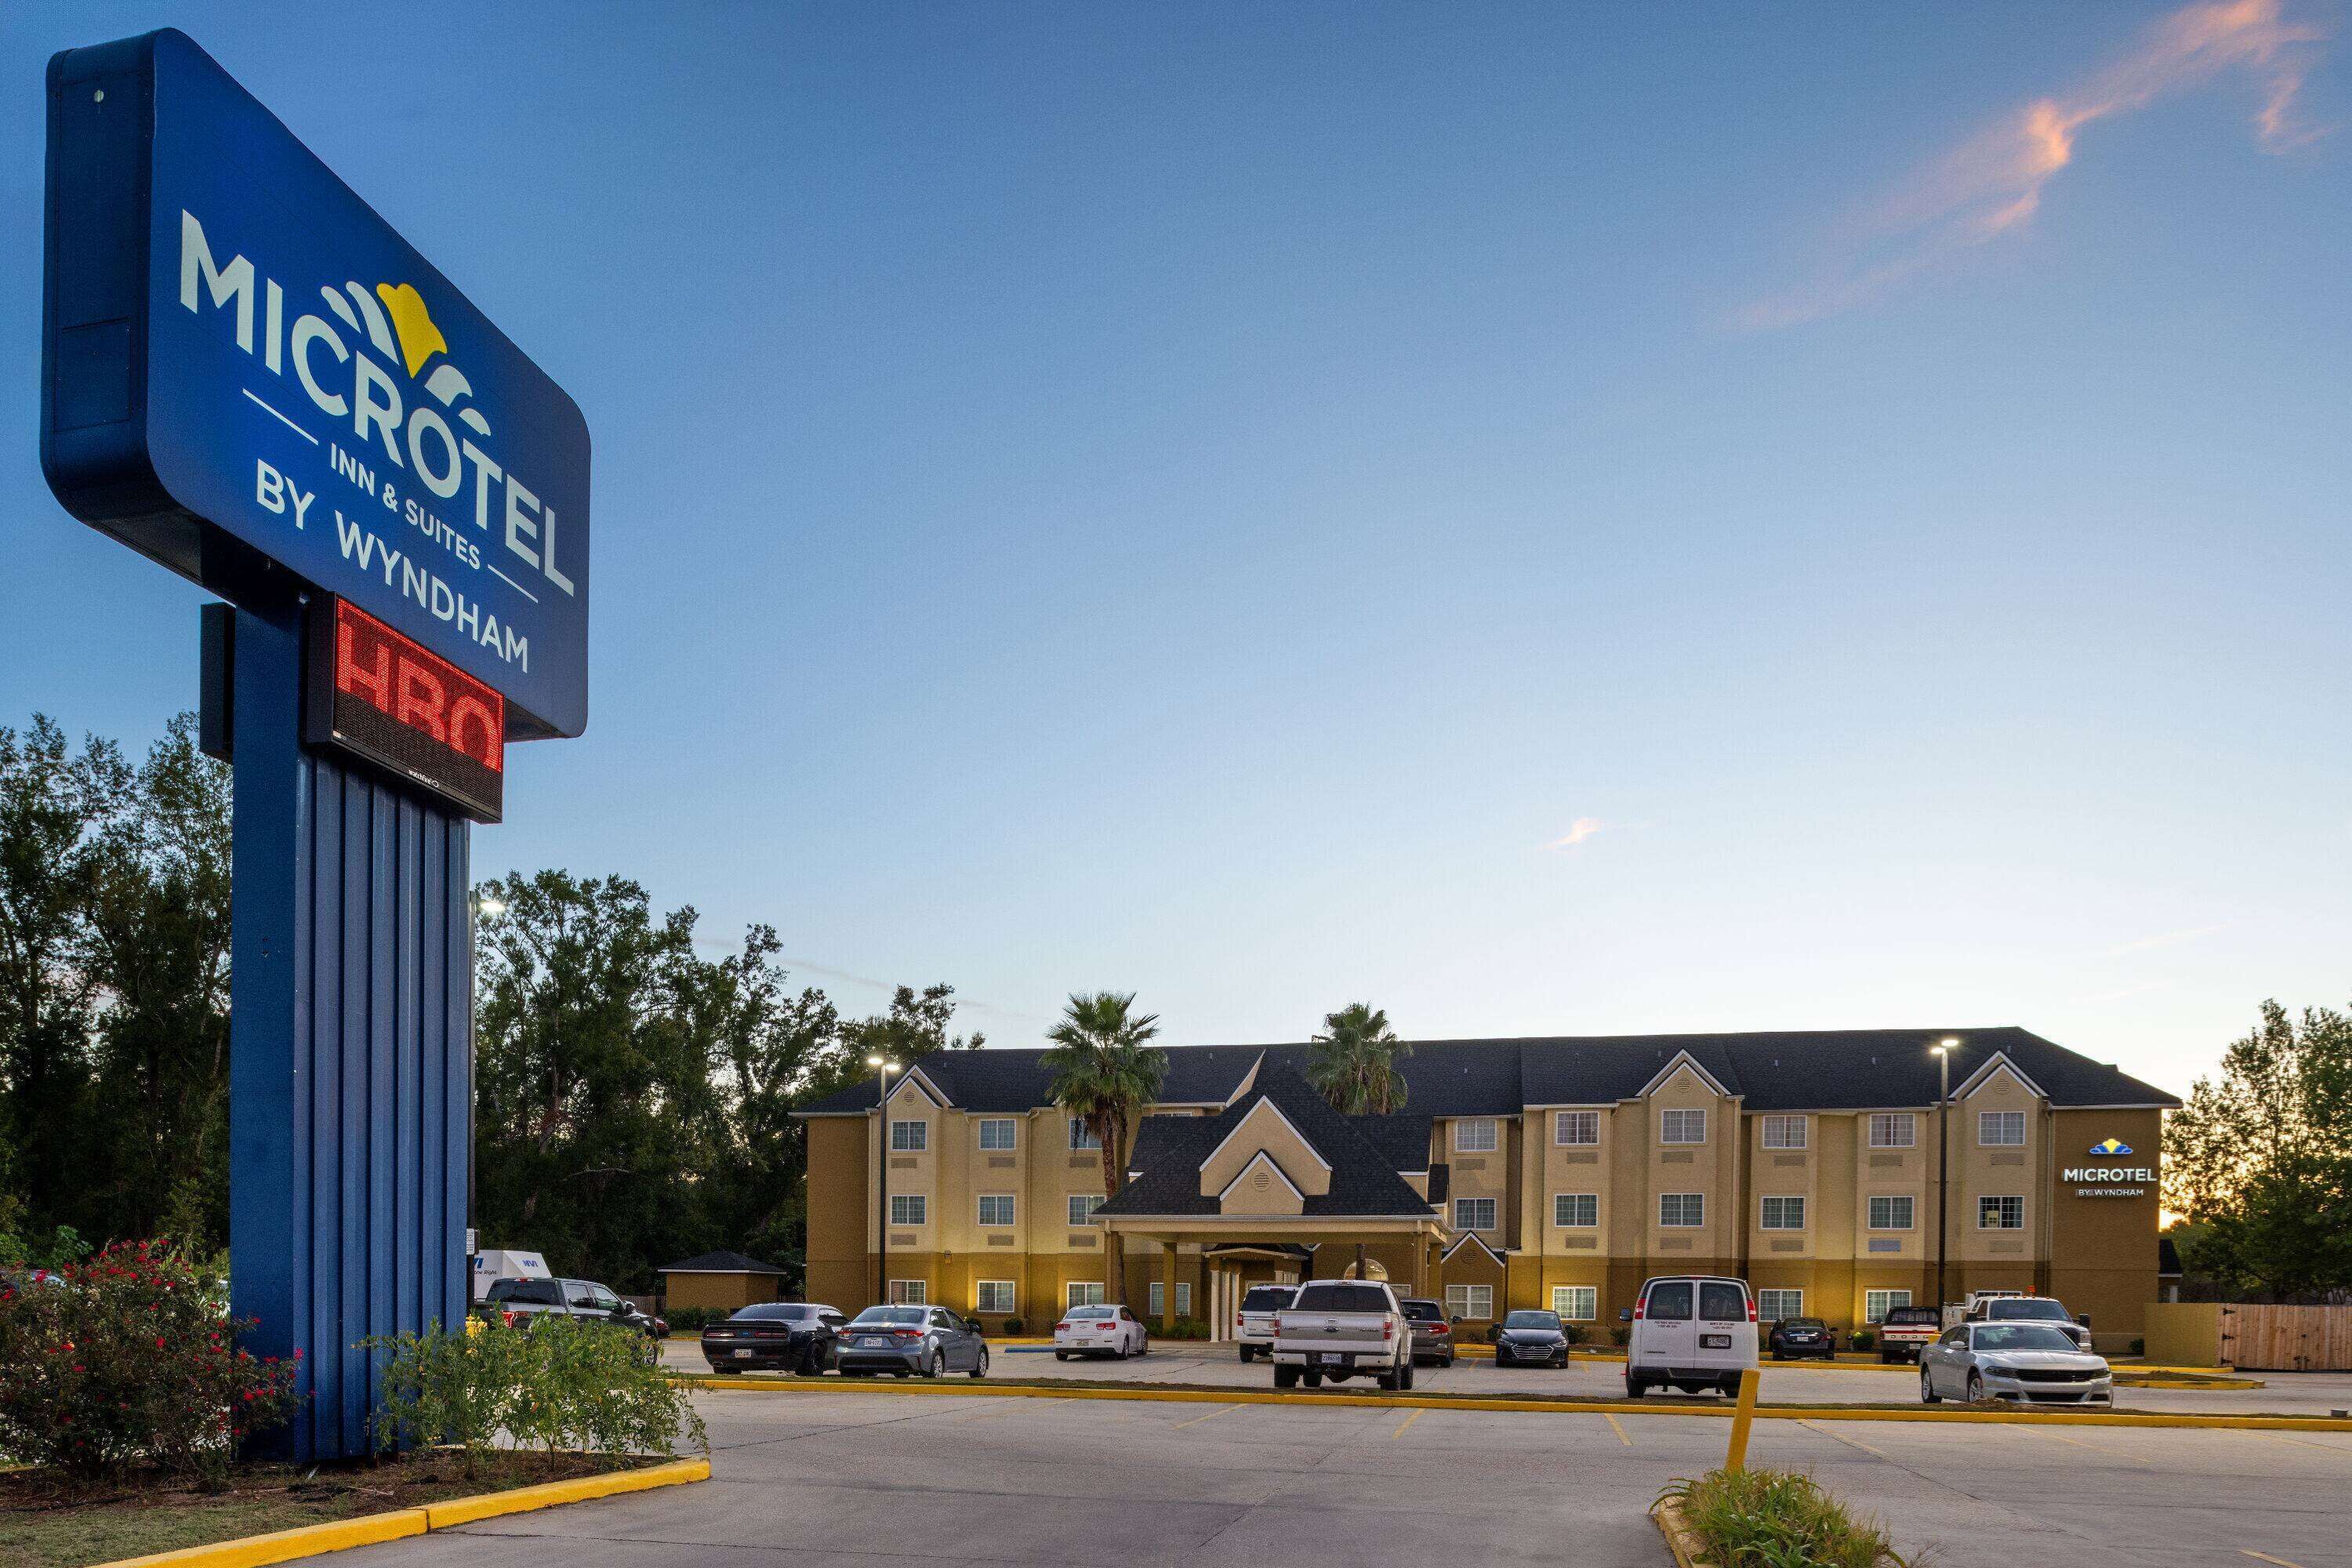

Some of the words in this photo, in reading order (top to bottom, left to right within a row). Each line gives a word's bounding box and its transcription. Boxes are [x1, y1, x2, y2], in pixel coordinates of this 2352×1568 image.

[180, 209, 575, 597] MICROTEL
[256, 459, 315, 530] BY
[334, 510, 528, 674] WYNDHAM
[330, 442, 376, 497] INN
[383, 482, 399, 512] &
[405, 499, 481, 571] SUITES
[2063, 1168, 2158, 1181] MICROTEL
